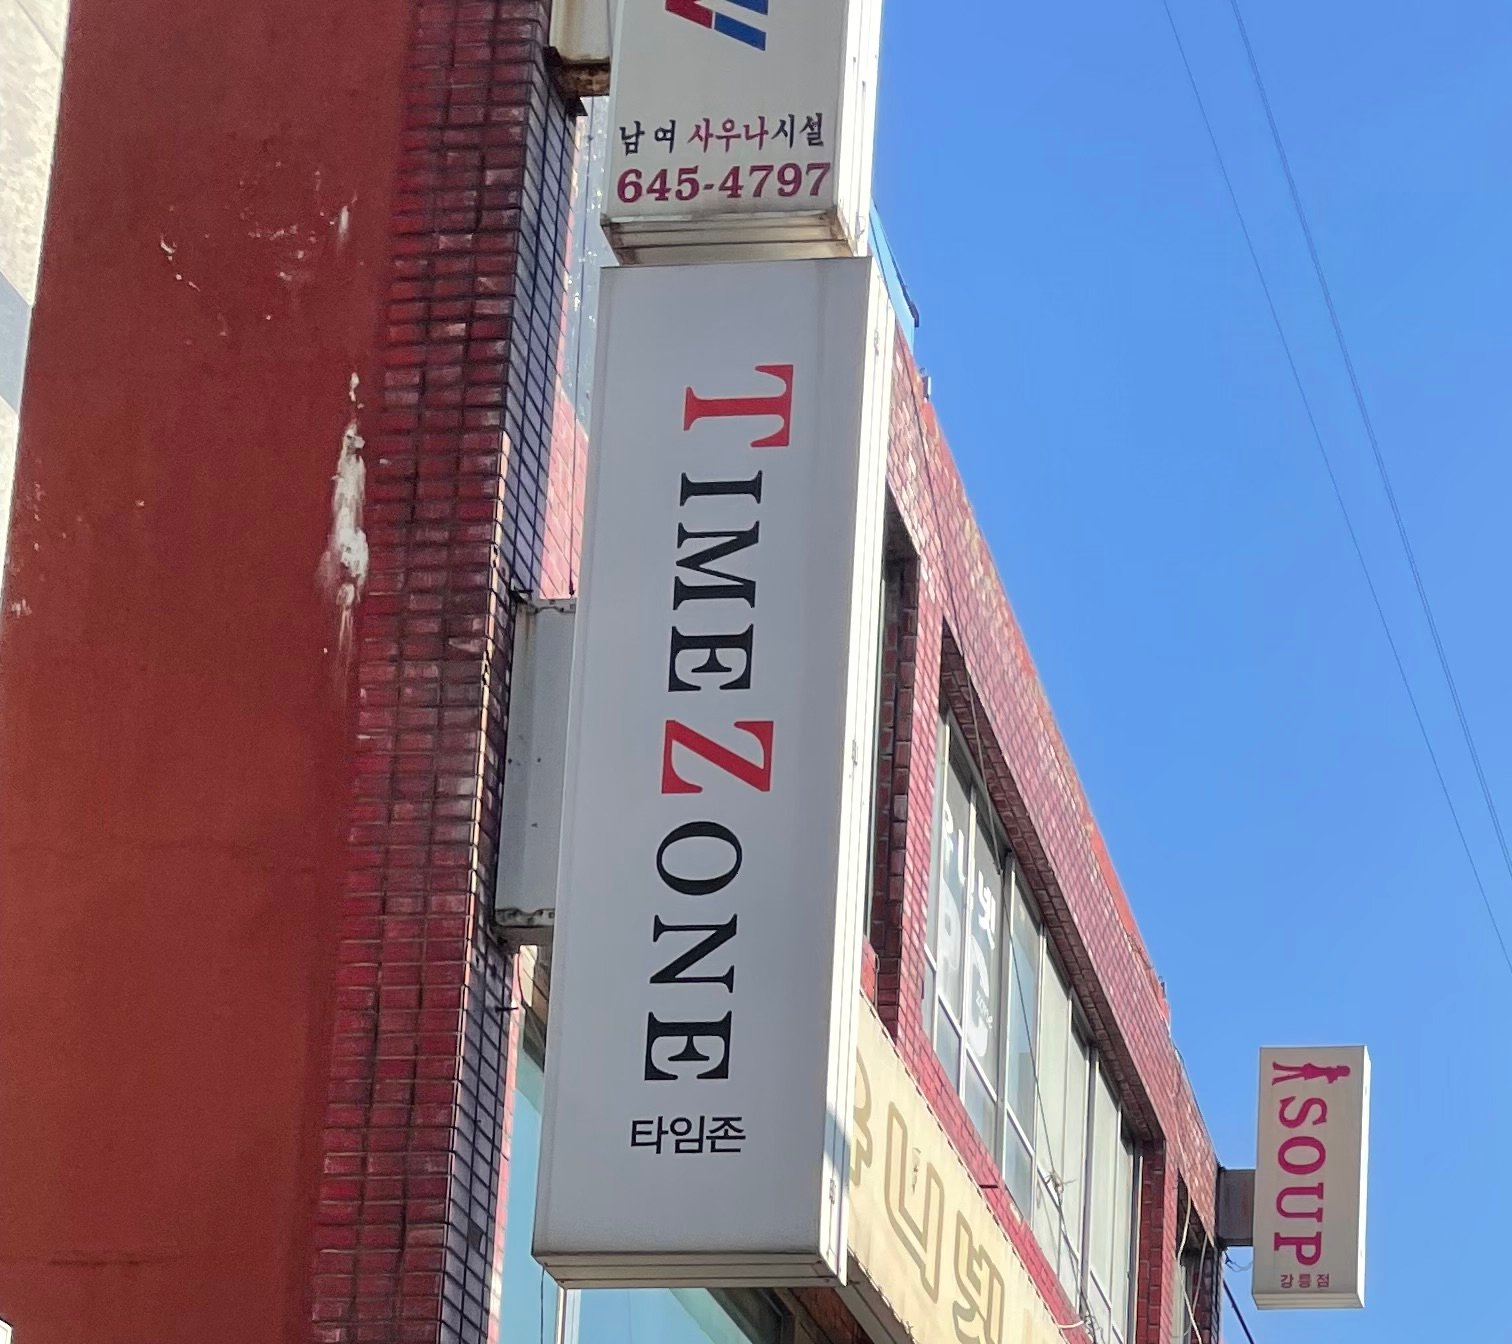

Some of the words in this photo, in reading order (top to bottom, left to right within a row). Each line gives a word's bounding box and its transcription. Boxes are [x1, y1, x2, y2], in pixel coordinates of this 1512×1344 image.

[619, 124, 646, 157] 남
[653, 121, 676, 154] 여
[687, 112, 826, 154] 사우나시설
[616, 160, 832, 204] 645-4797
[644, 363, 795, 1082] TIMEZONE
[629, 1114, 747, 1156] 타임존
[1273, 1095, 1328, 1266] SOUP
